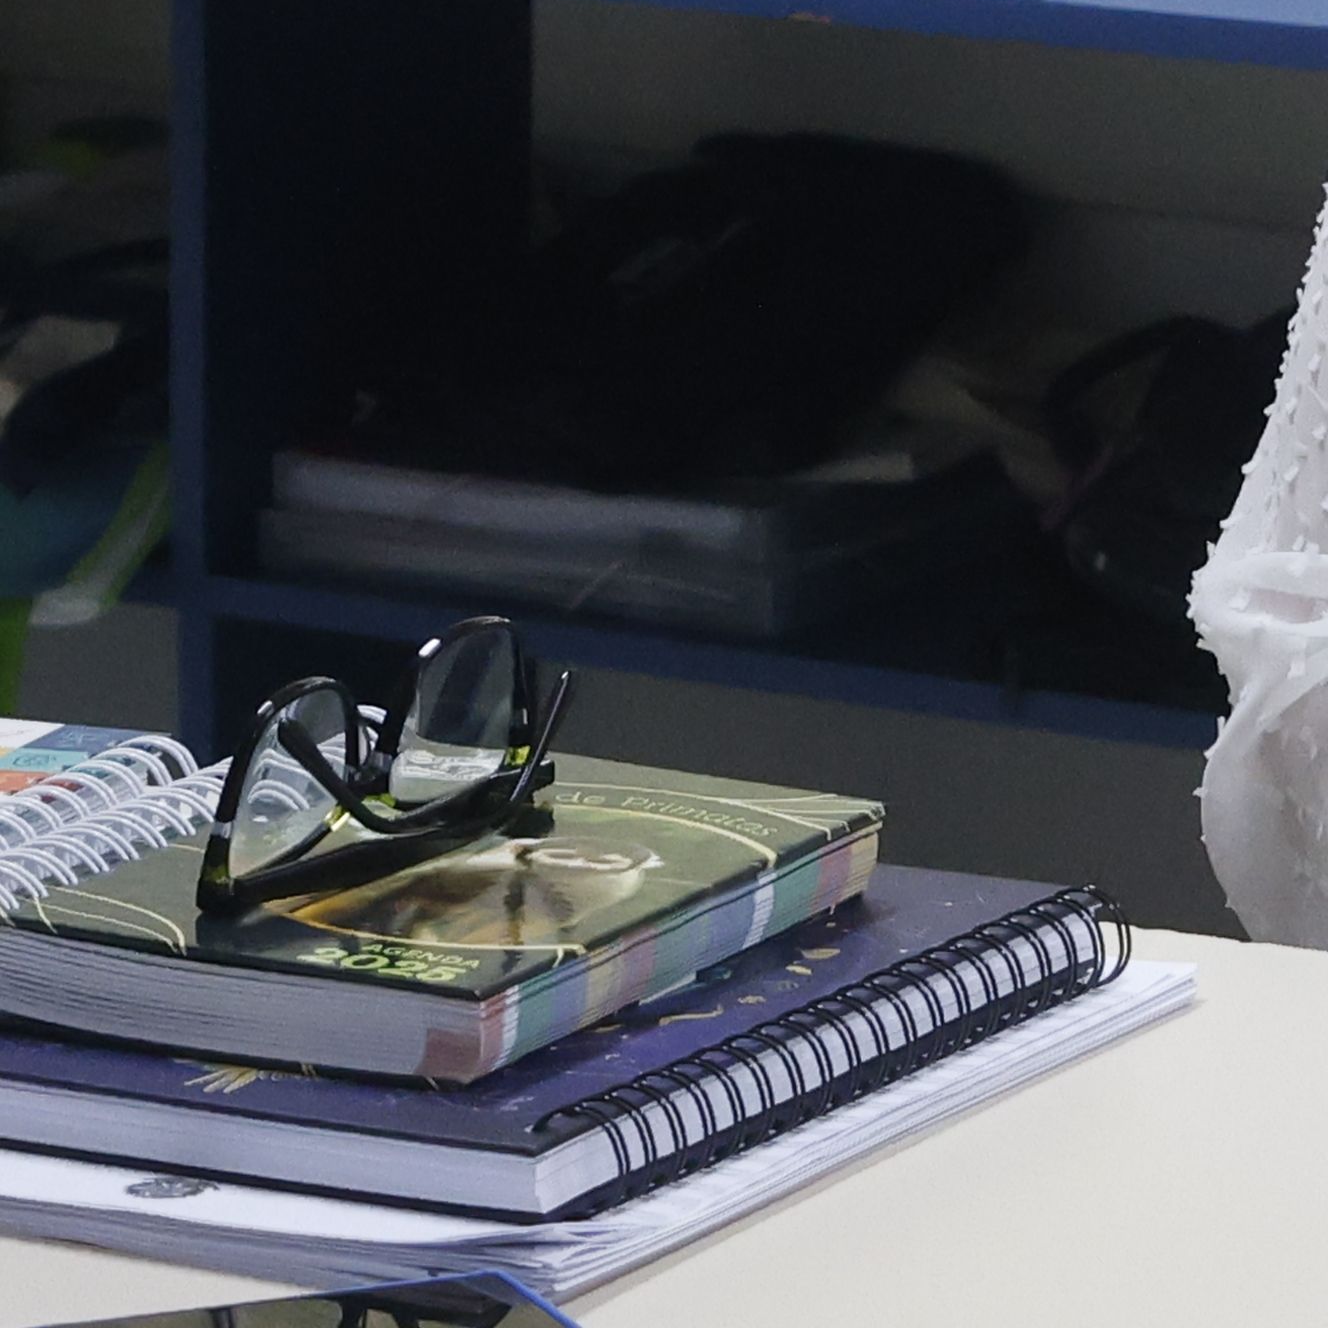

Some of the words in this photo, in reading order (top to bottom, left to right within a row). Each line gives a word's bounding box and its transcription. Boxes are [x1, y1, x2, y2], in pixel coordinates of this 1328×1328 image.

[555, 790, 606, 804] de
[621, 795, 779, 837] Primates
[296, 946, 467, 982] 2025
[361, 944, 480, 969] AGENDA
